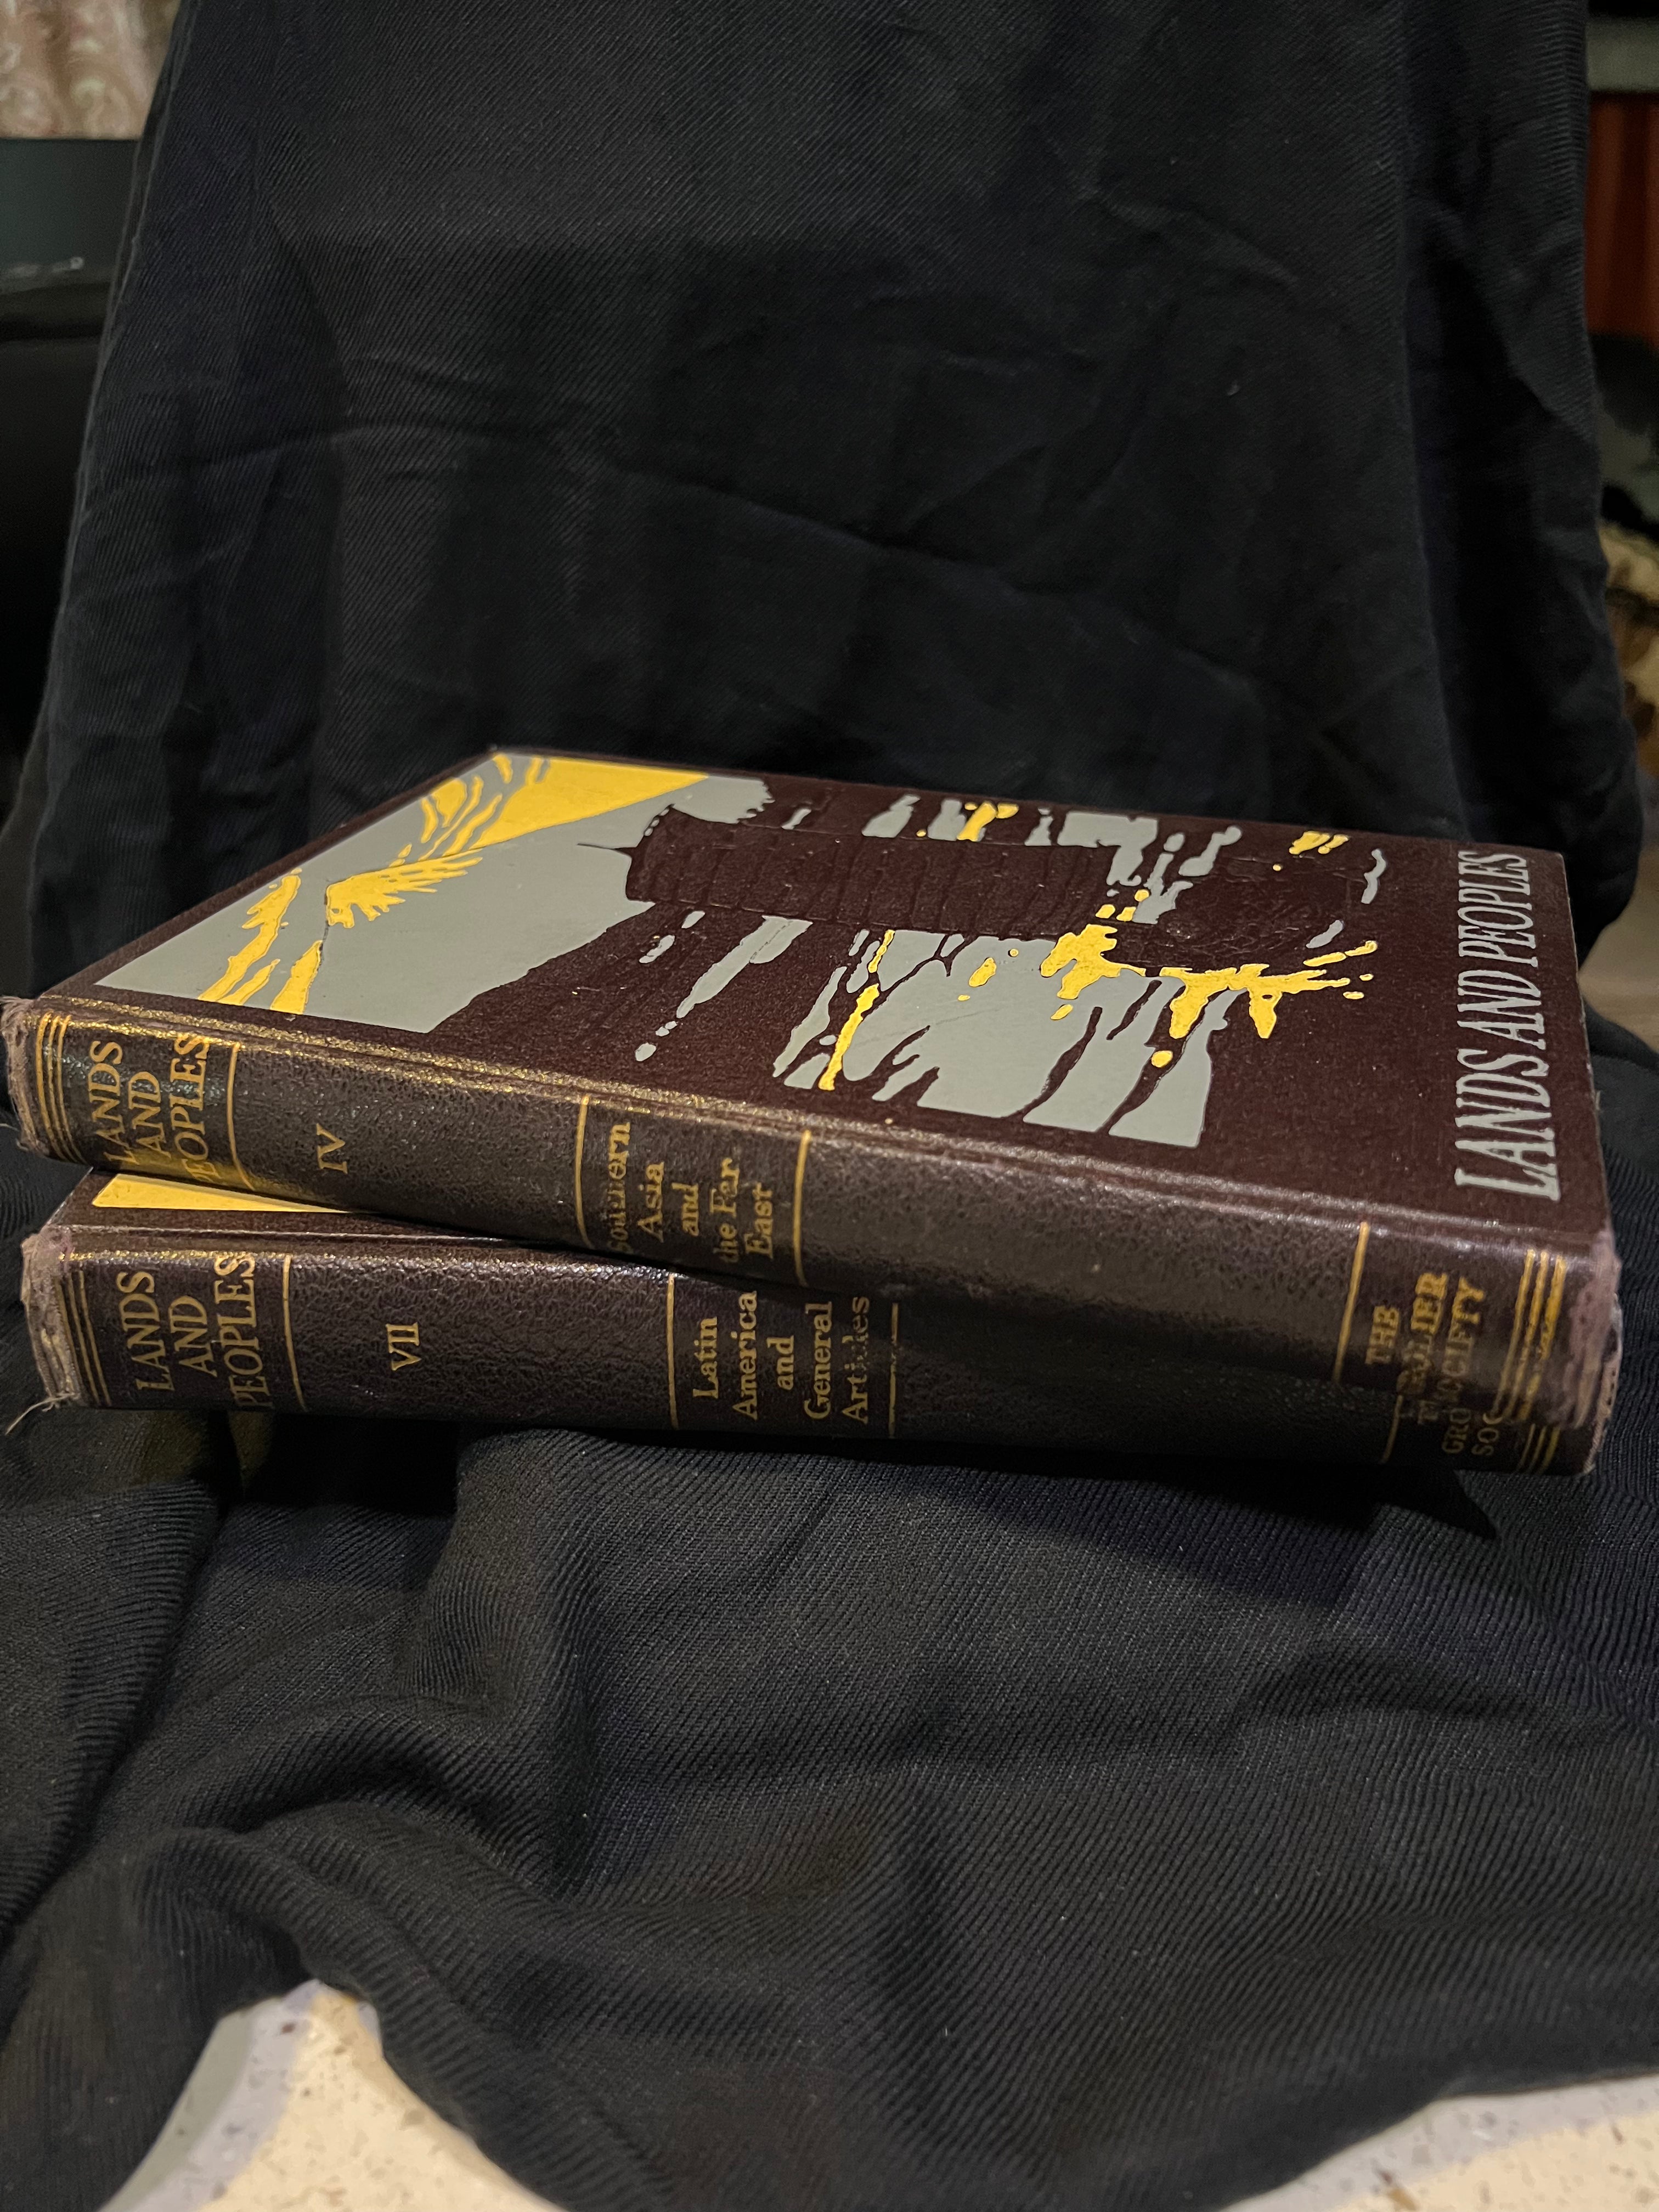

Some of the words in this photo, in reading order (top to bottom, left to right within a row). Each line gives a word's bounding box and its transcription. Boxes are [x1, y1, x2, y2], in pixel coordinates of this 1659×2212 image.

[1457, 850, 1538, 967] PEOPLES
[1457, 969, 1546, 1050] AND
[88, 1041, 139, 1165] LANDS
[128, 1071, 171, 1159] AND
[1454, 1048, 1560, 1201] LANDS
[317, 1123, 348, 1174] IV
[637, 1161, 664, 1243] Asia
[672, 1183, 699, 1237] and
[744, 1182, 774, 1259] East
[116, 1271, 174, 1391] LANDS
[168, 1295, 217, 1377] AND
[213, 1254, 274, 1407] PEOPLES
[386, 1322, 421, 1371] VII
[693, 1316, 719, 1398] Latin
[730, 1290, 758, 1420] America
[767, 1335, 794, 1391] and
[804, 1301, 832, 1420] General
